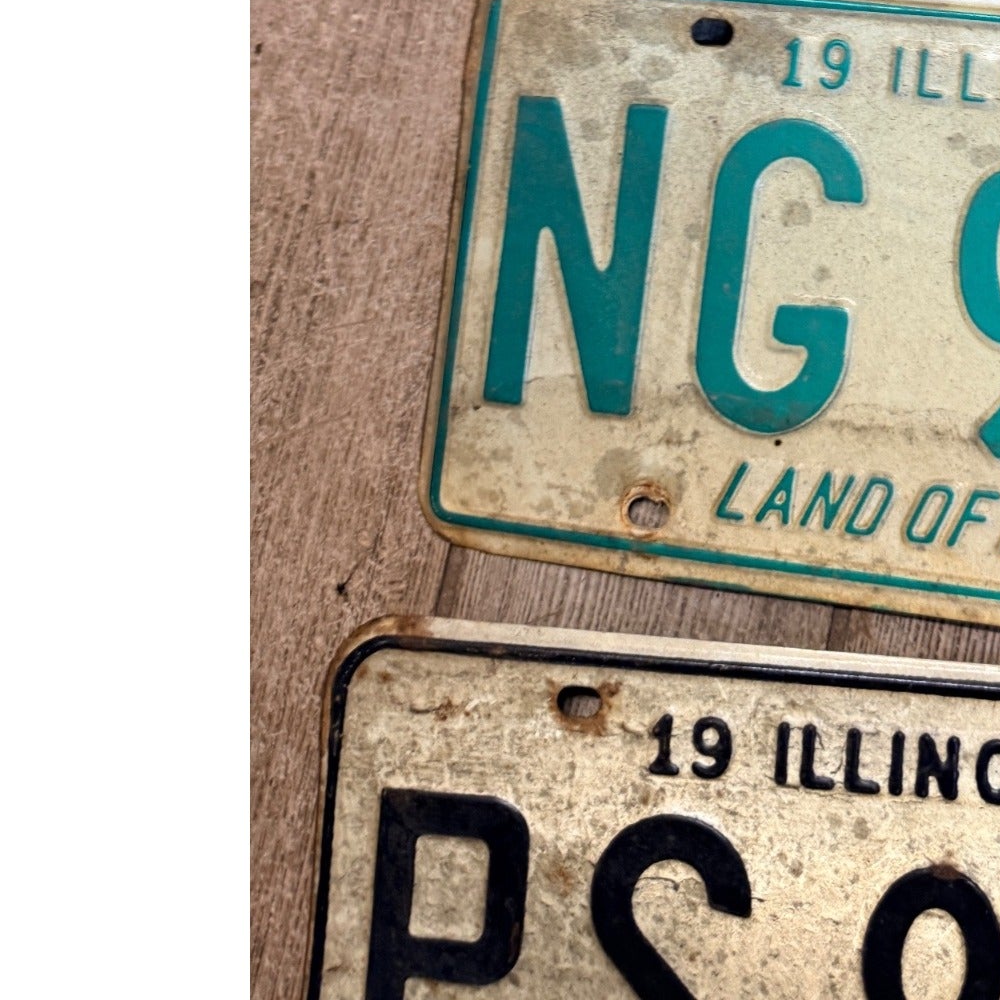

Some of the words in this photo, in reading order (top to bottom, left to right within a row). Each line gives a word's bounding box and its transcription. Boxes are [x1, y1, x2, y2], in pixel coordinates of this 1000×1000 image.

[781, 38, 853, 90] 19
[484, 94, 865, 435] NG
[716, 461, 894, 536] LAND
[906, 485, 1000, 547] OF
[648, 713, 733, 780] 19
